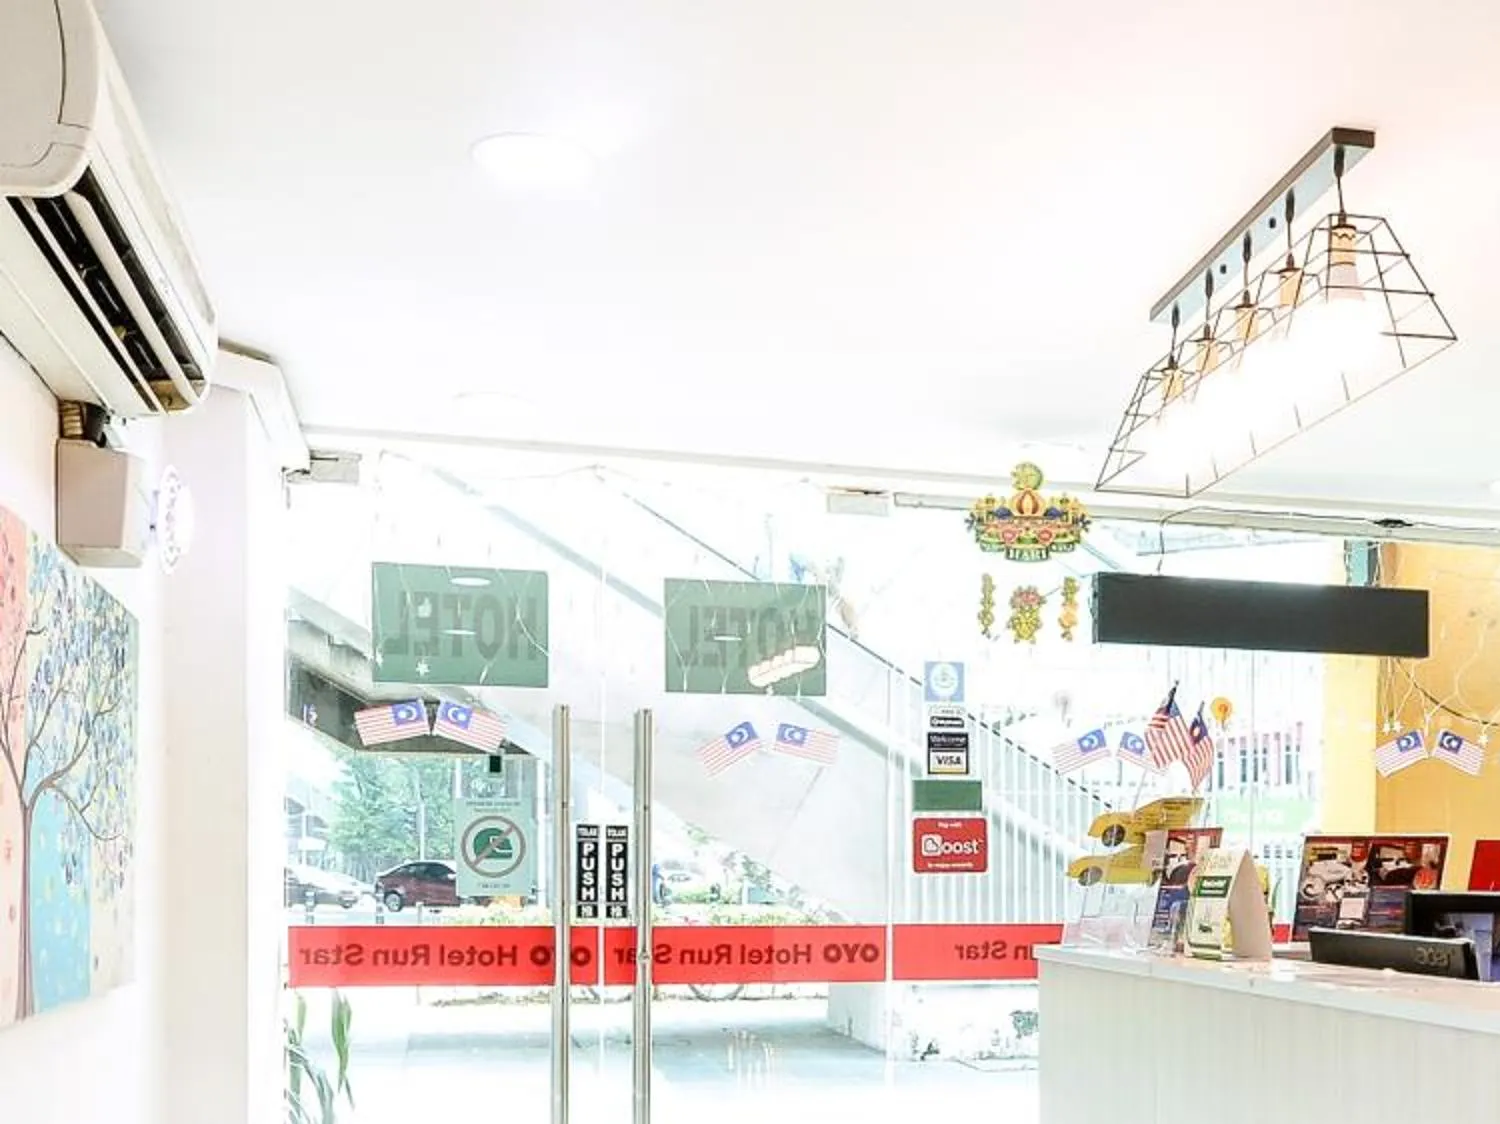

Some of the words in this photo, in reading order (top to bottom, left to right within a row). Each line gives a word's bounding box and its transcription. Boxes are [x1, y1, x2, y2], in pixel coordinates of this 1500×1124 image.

[936, 755, 962, 765] VISA
[581, 843, 595, 901] PUSH
[611, 843, 625, 901] PUSH
